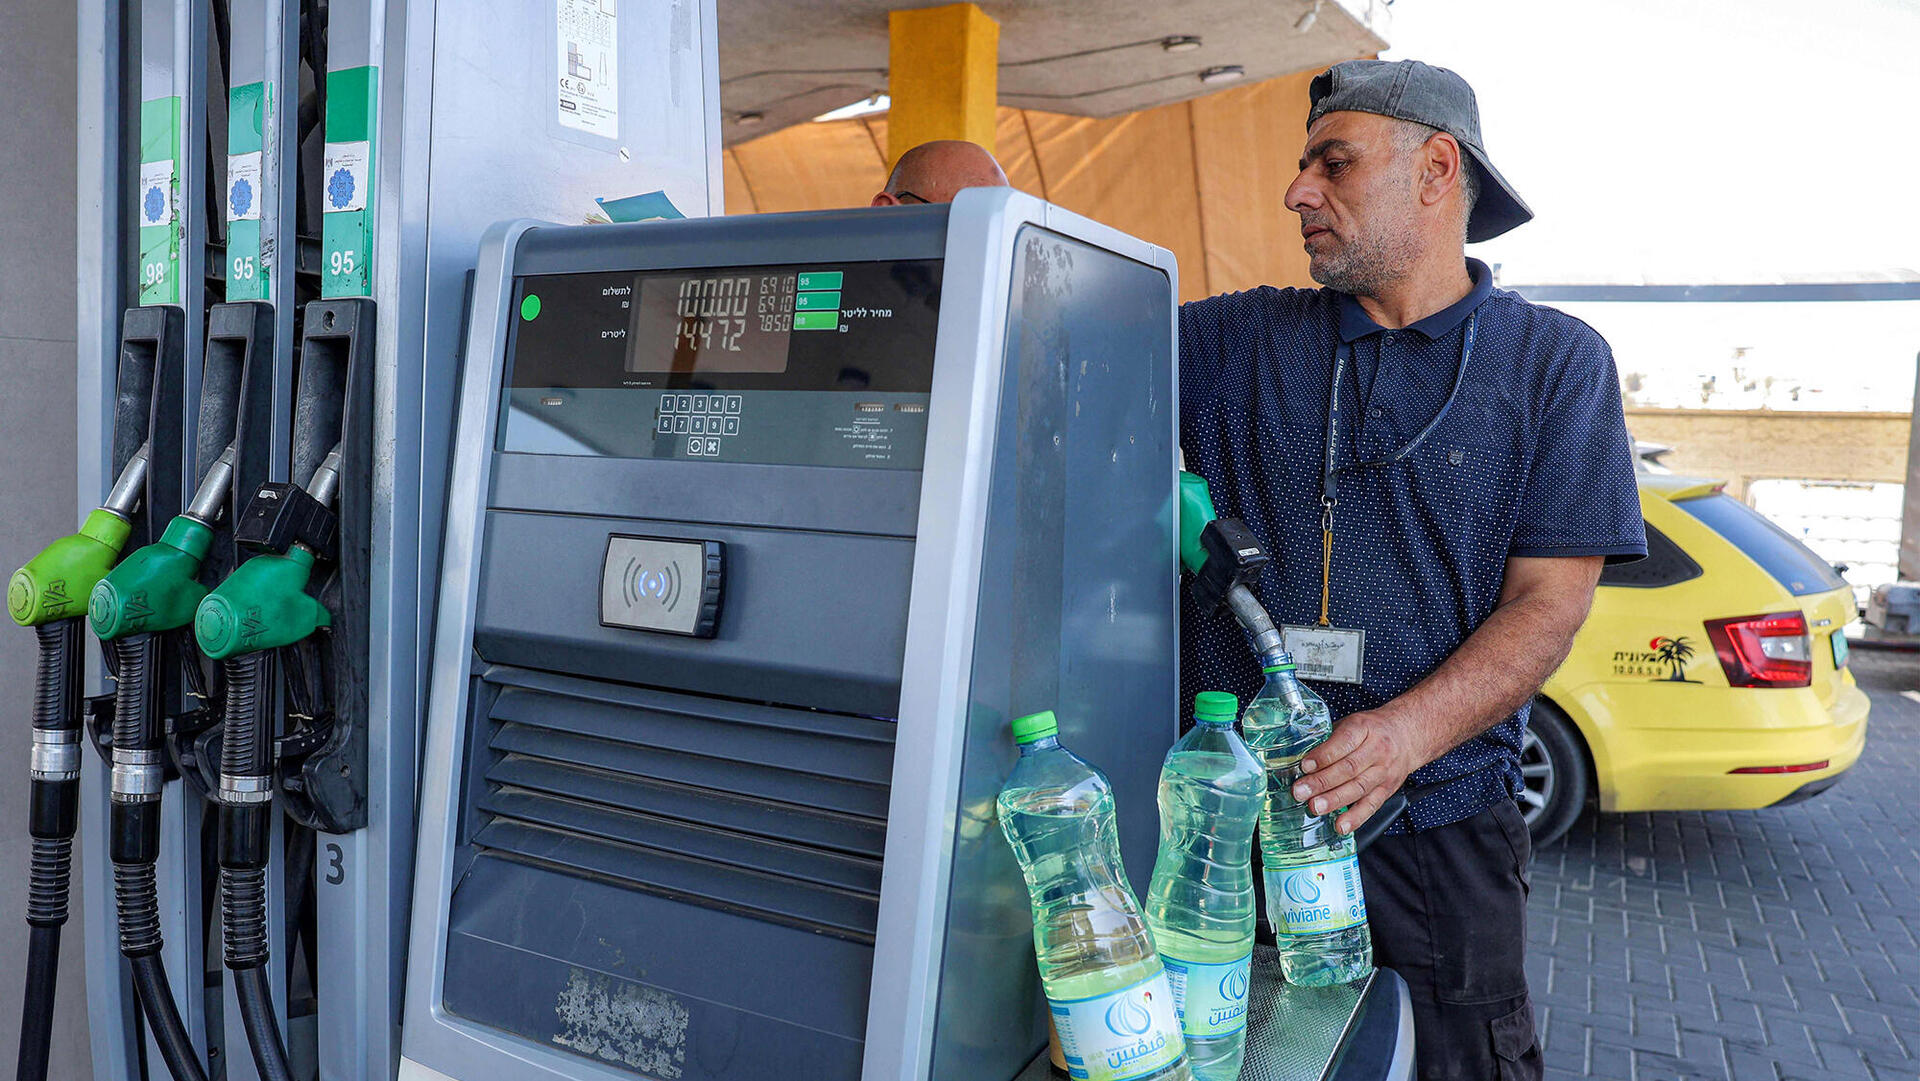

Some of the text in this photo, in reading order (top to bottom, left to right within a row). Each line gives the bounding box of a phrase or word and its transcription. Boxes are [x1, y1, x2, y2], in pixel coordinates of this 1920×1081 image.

[233, 256, 254, 280] 95
[331, 250, 354, 276] 95
[146, 262, 164, 285] 98
[602, 286, 631, 296] לתשלום
[677, 278, 751, 317] 100.00
[841, 307, 892, 319] מחיר לליטר
[601, 329, 626, 338] ליטרים
[666, 400, 670, 408] 1
[681, 400, 687, 408] 2
[697, 400, 703, 408] 3
[730, 401, 736, 409] 5
[663, 420, 668, 428] 6
[695, 421, 700, 429] 8
[712, 422, 717, 430] 9
[728, 422, 734, 430] 0
[325, 843, 345, 885] 3
[1283, 907, 1331, 924] viviane
